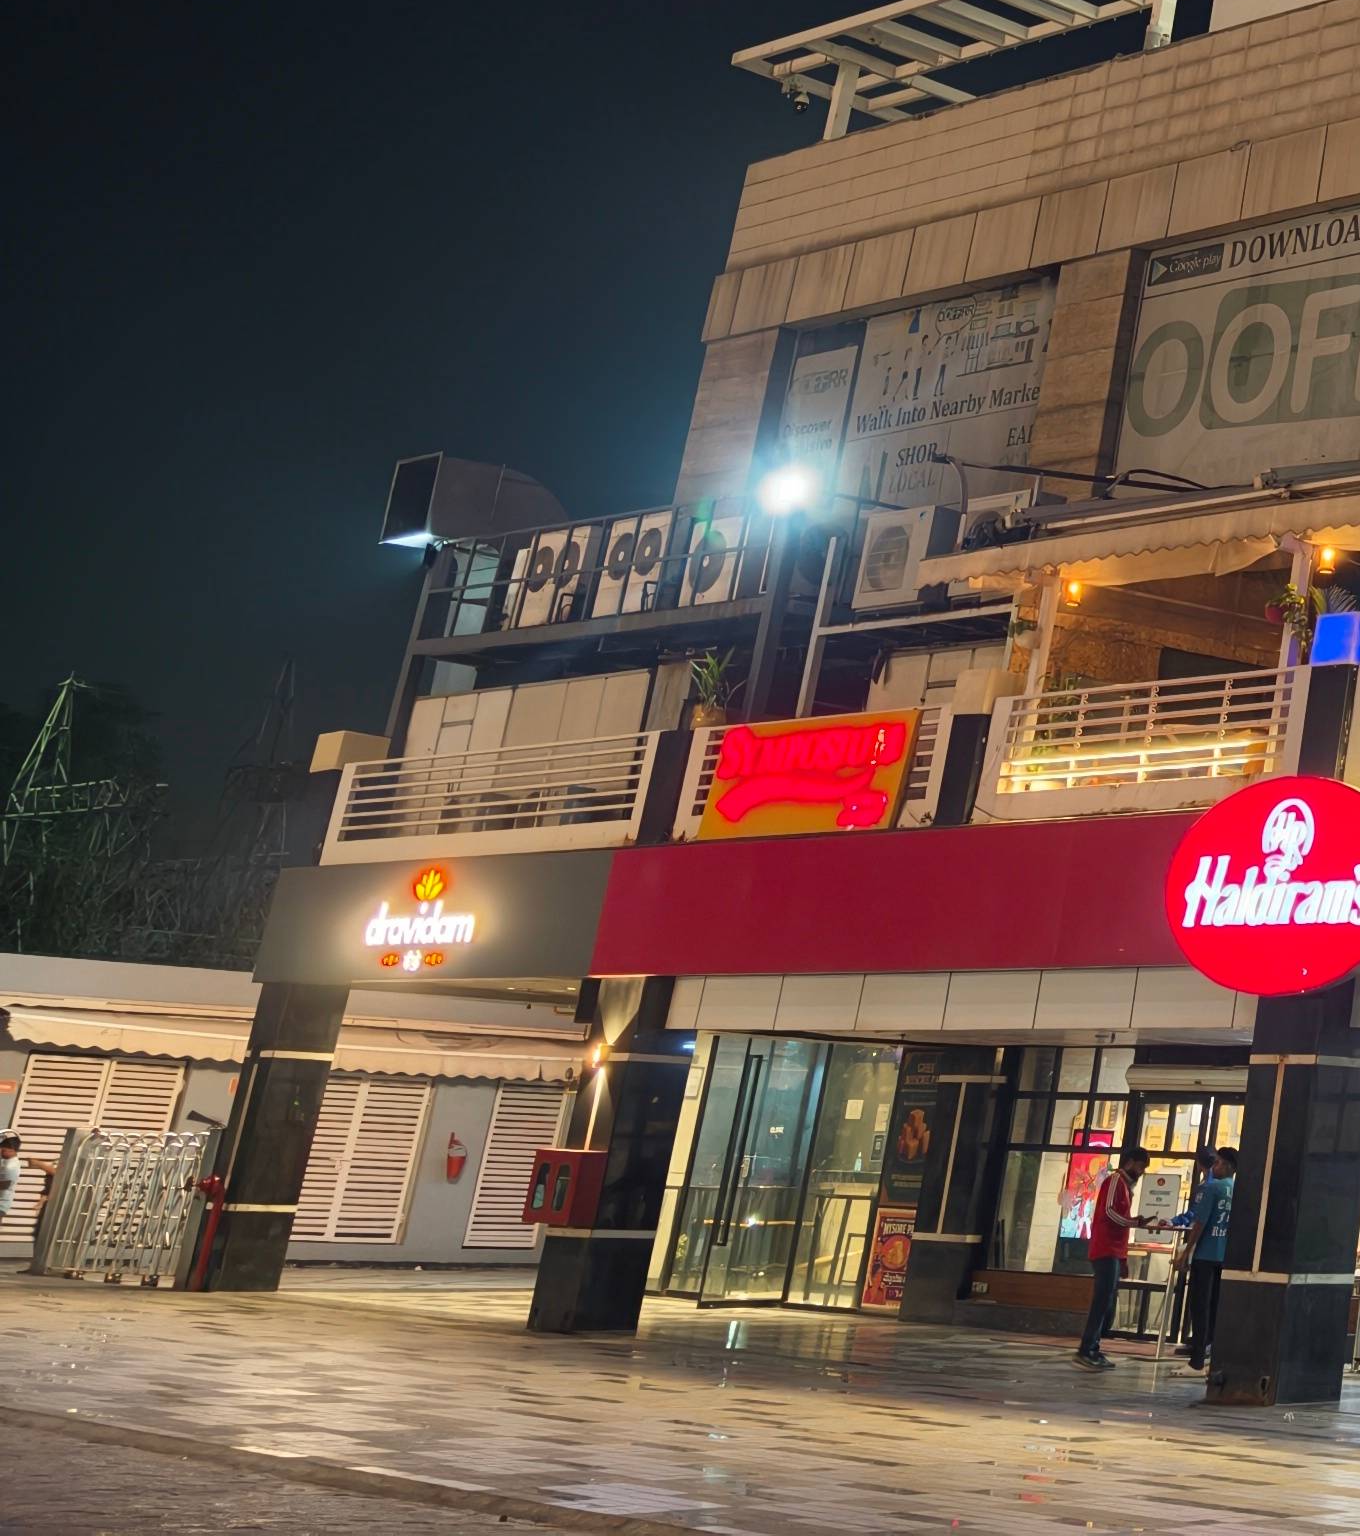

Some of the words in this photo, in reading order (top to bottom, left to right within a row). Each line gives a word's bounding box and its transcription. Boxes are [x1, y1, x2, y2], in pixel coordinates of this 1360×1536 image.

[856, 405, 892, 434] Walk
[896, 405, 926, 427] Into
[930, 395, 986, 421] Nearby
[365, 900, 475, 946] dravidam
